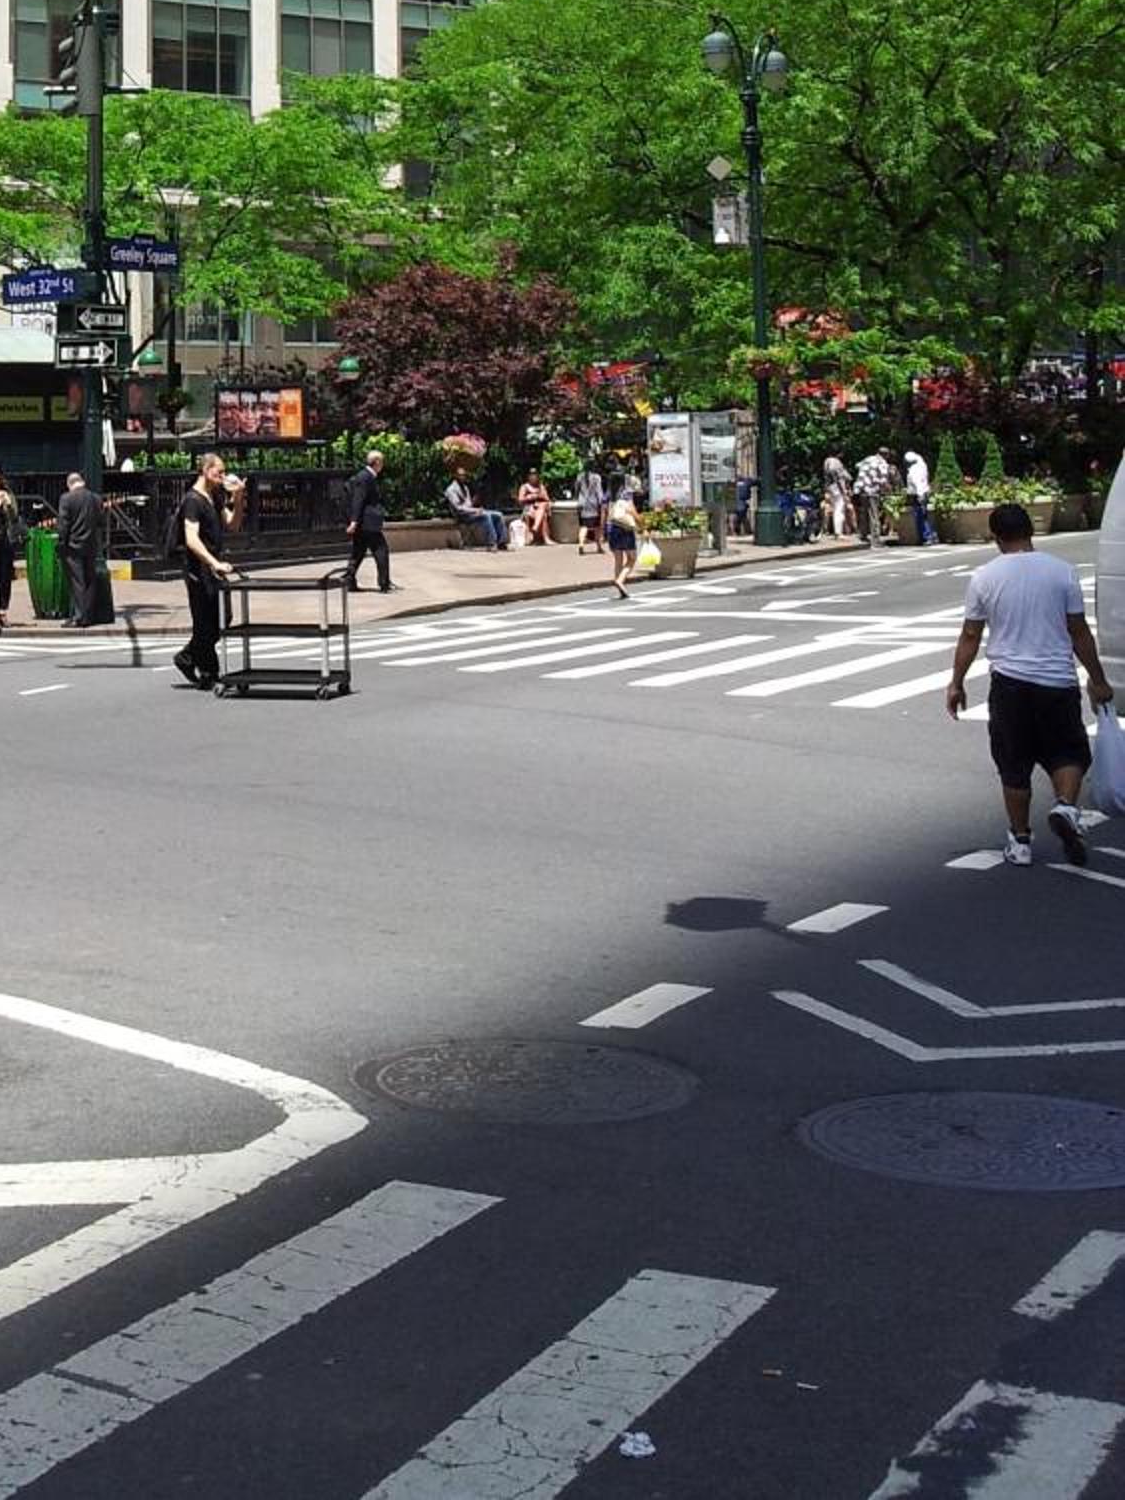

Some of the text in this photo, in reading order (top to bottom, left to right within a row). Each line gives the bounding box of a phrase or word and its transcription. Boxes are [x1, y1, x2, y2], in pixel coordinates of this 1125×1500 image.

[111, 245, 177, 268] Greeley Square
[8, 276, 74, 297] West 32nd St
